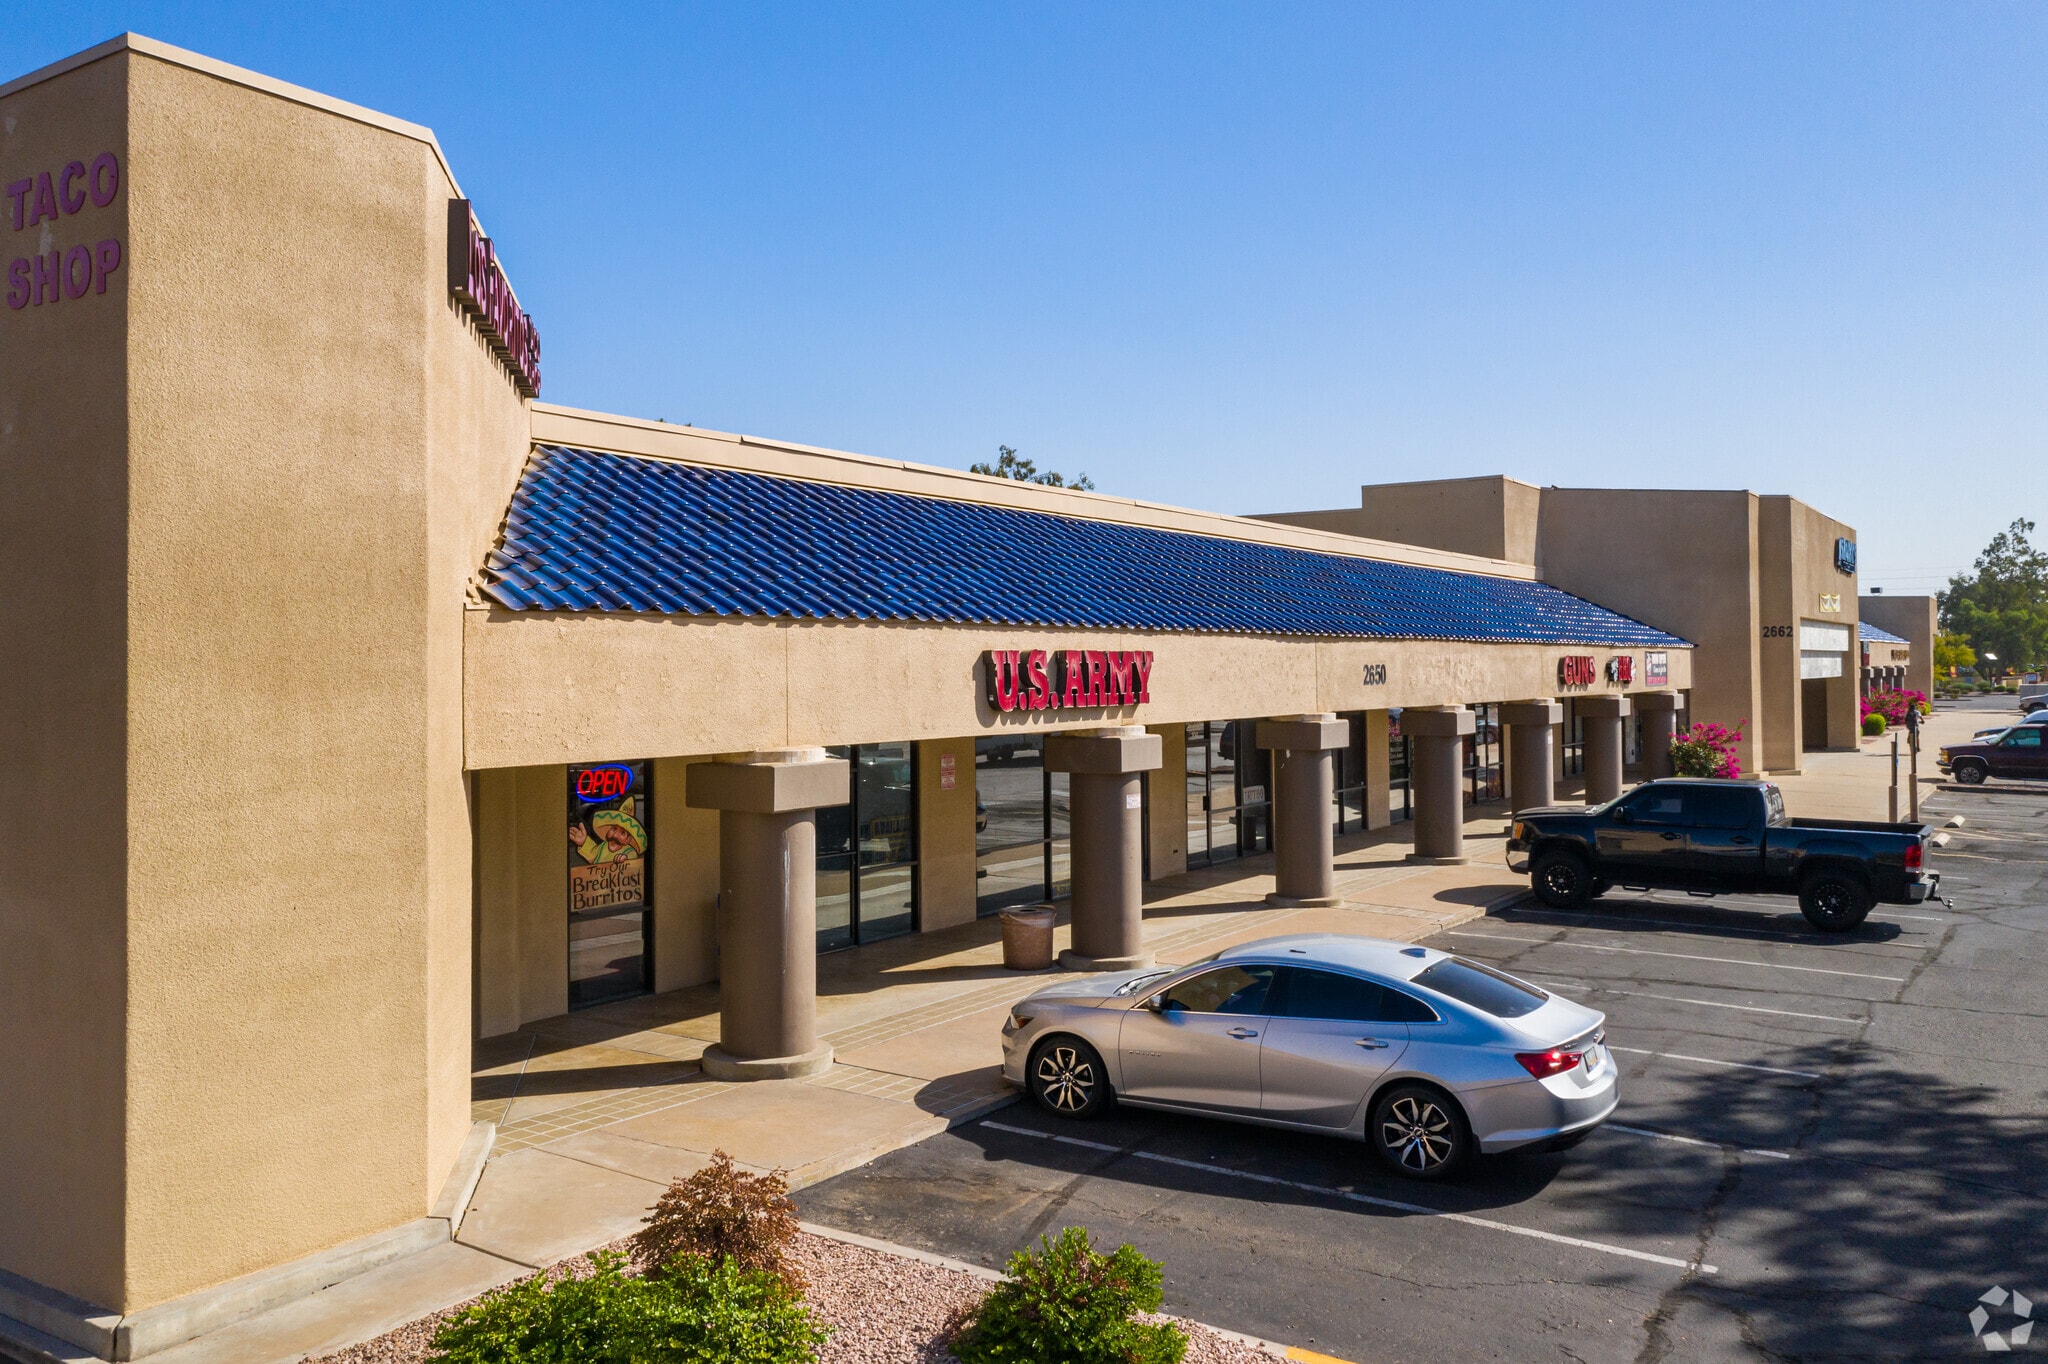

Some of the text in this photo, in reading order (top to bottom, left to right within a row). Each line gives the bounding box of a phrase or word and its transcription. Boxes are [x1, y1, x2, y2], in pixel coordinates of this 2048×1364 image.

[6, 152, 119, 231] TACO
[6, 238, 121, 310] SHOP
[1763, 625, 1793, 637] 2662
[991, 649, 1154, 712] U.S. ARMY
[1363, 664, 1386, 685] 2650
[1563, 655, 1596, 685] GUNS
[578, 770, 628, 795] OPEN
[573, 868, 642, 893] Breakfast
[587, 862, 630, 878] Try Our
[573, 887, 642, 910] Burritos
